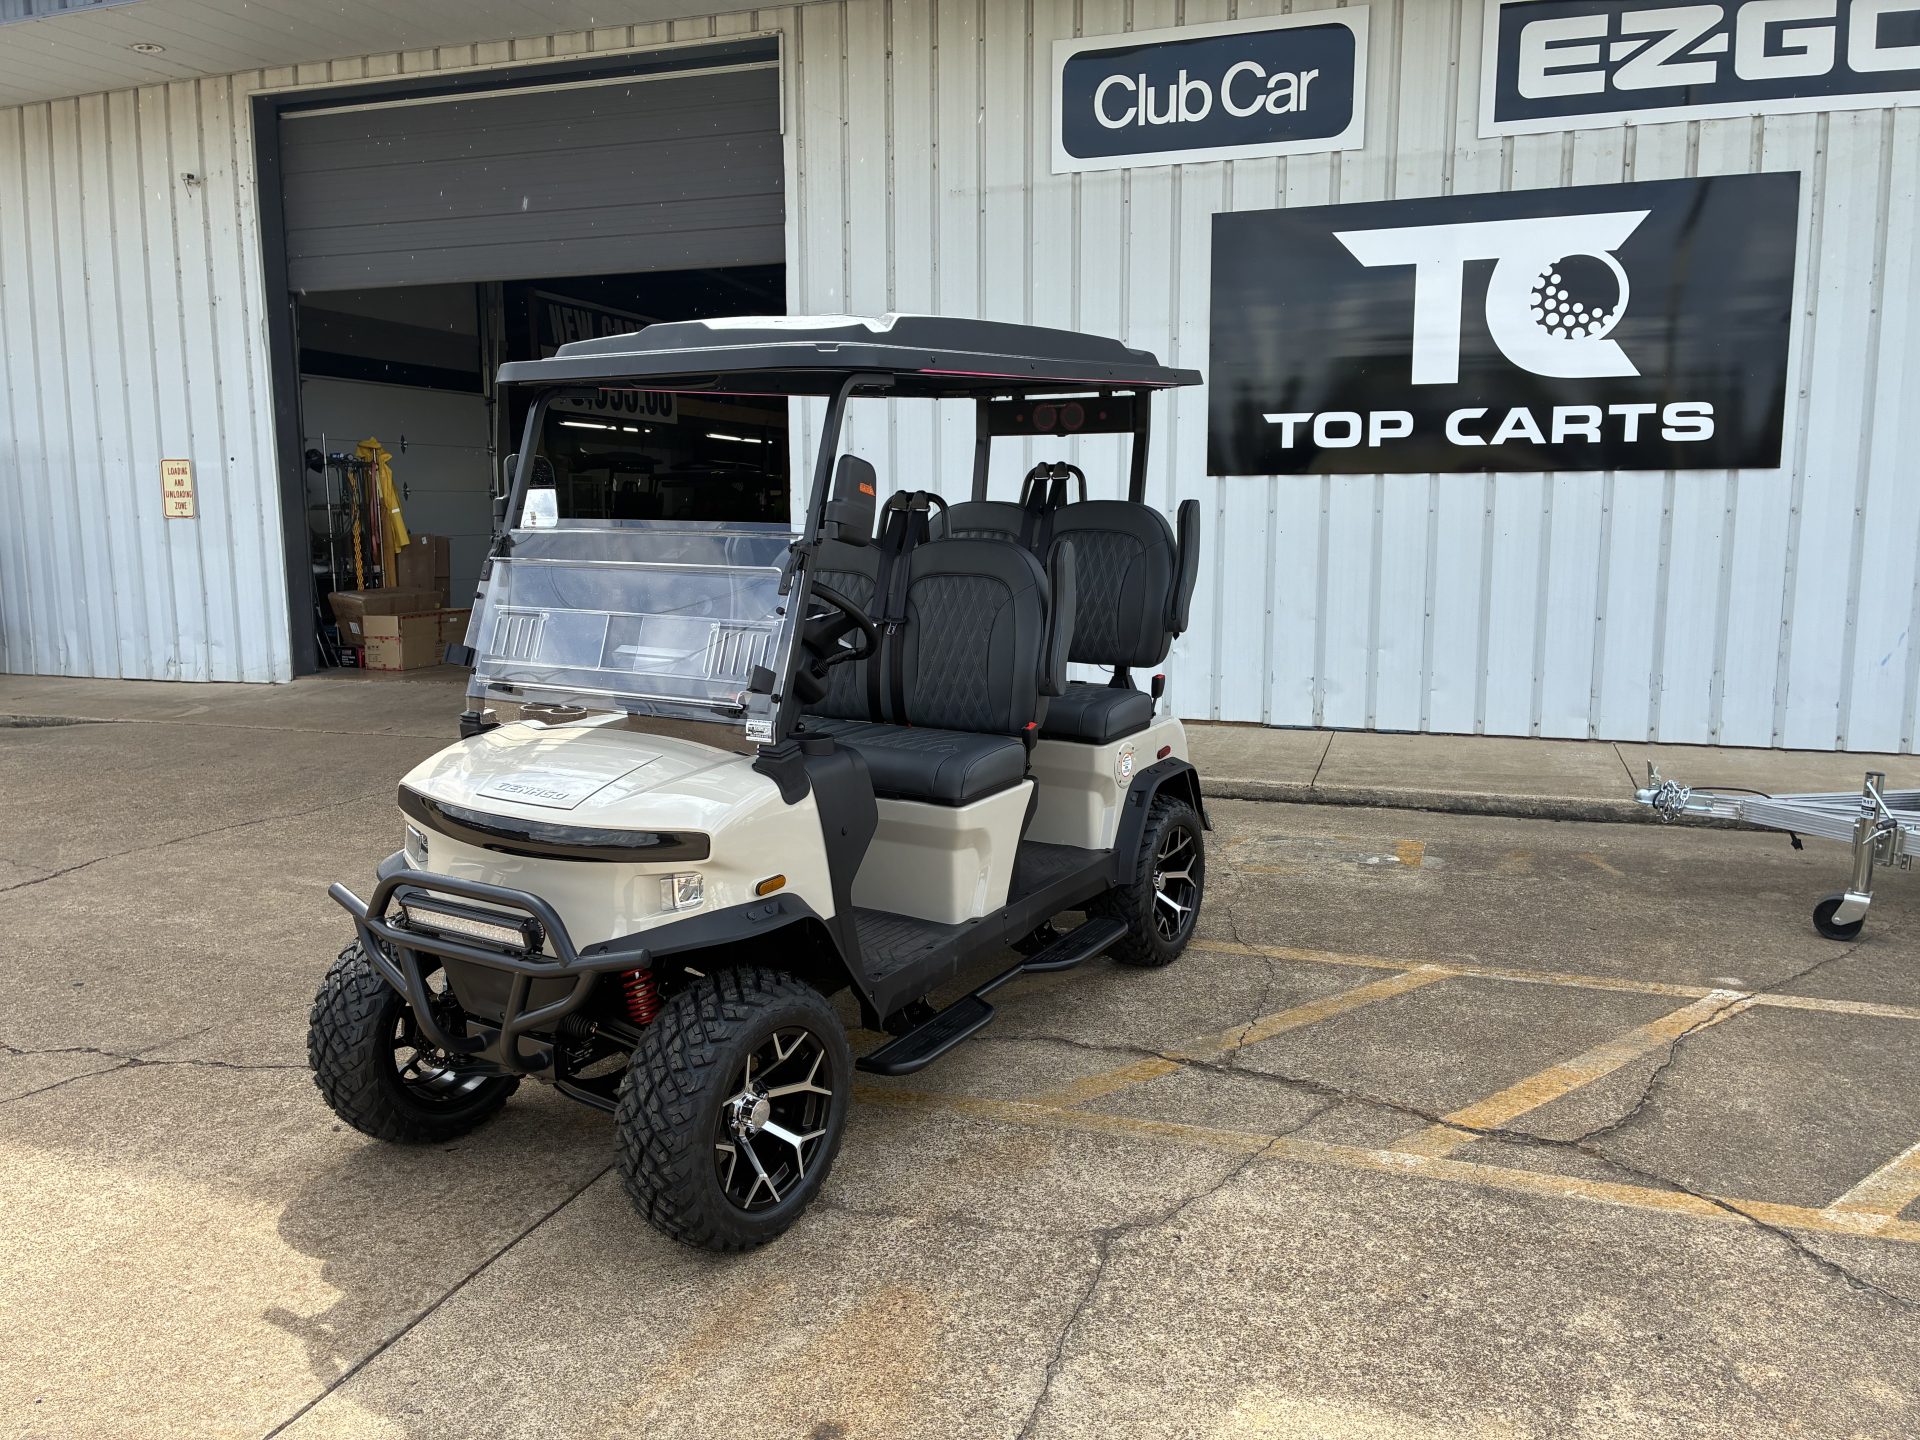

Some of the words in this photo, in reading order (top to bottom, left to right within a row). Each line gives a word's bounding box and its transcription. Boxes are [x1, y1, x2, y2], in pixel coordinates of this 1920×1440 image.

[1094, 69, 1212, 129] Club
[1221, 60, 1319, 117] Car
[548, 303, 594, 344] NEW
[1262, 410, 1414, 449] TOP
[1445, 401, 1715, 446] CARTS
[167, 467, 188, 475] LOADING
[166, 490, 192, 498] UNLOADING
[174, 501, 187, 510] ZONE
